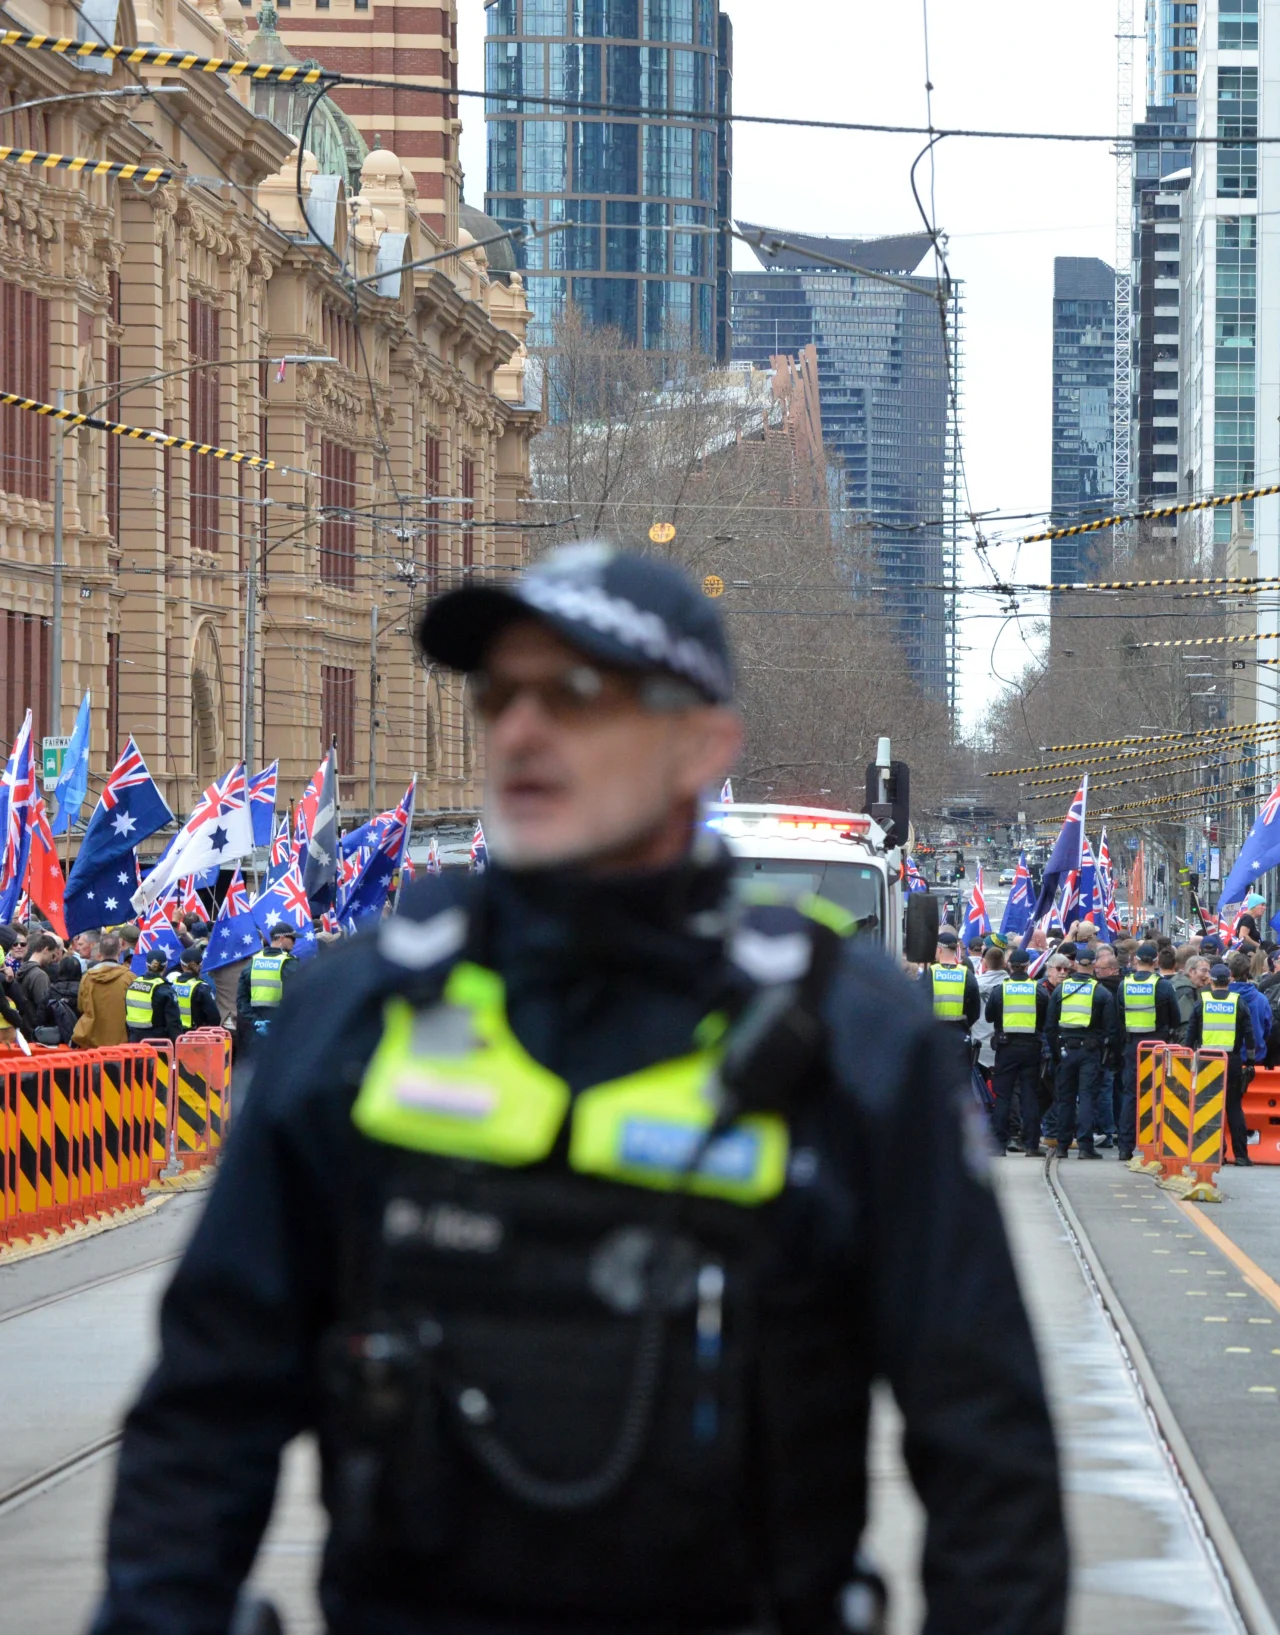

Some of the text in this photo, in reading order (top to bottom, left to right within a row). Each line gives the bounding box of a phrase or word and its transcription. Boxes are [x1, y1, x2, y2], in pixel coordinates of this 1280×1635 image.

[254, 960, 280, 969] Police
[935, 971, 963, 981] Police
[130, 982, 151, 992] Police
[1006, 984, 1034, 994] Police
[1064, 984, 1091, 994] Police
[1126, 984, 1153, 994] Police
[1206, 1002, 1234, 1013] Police
